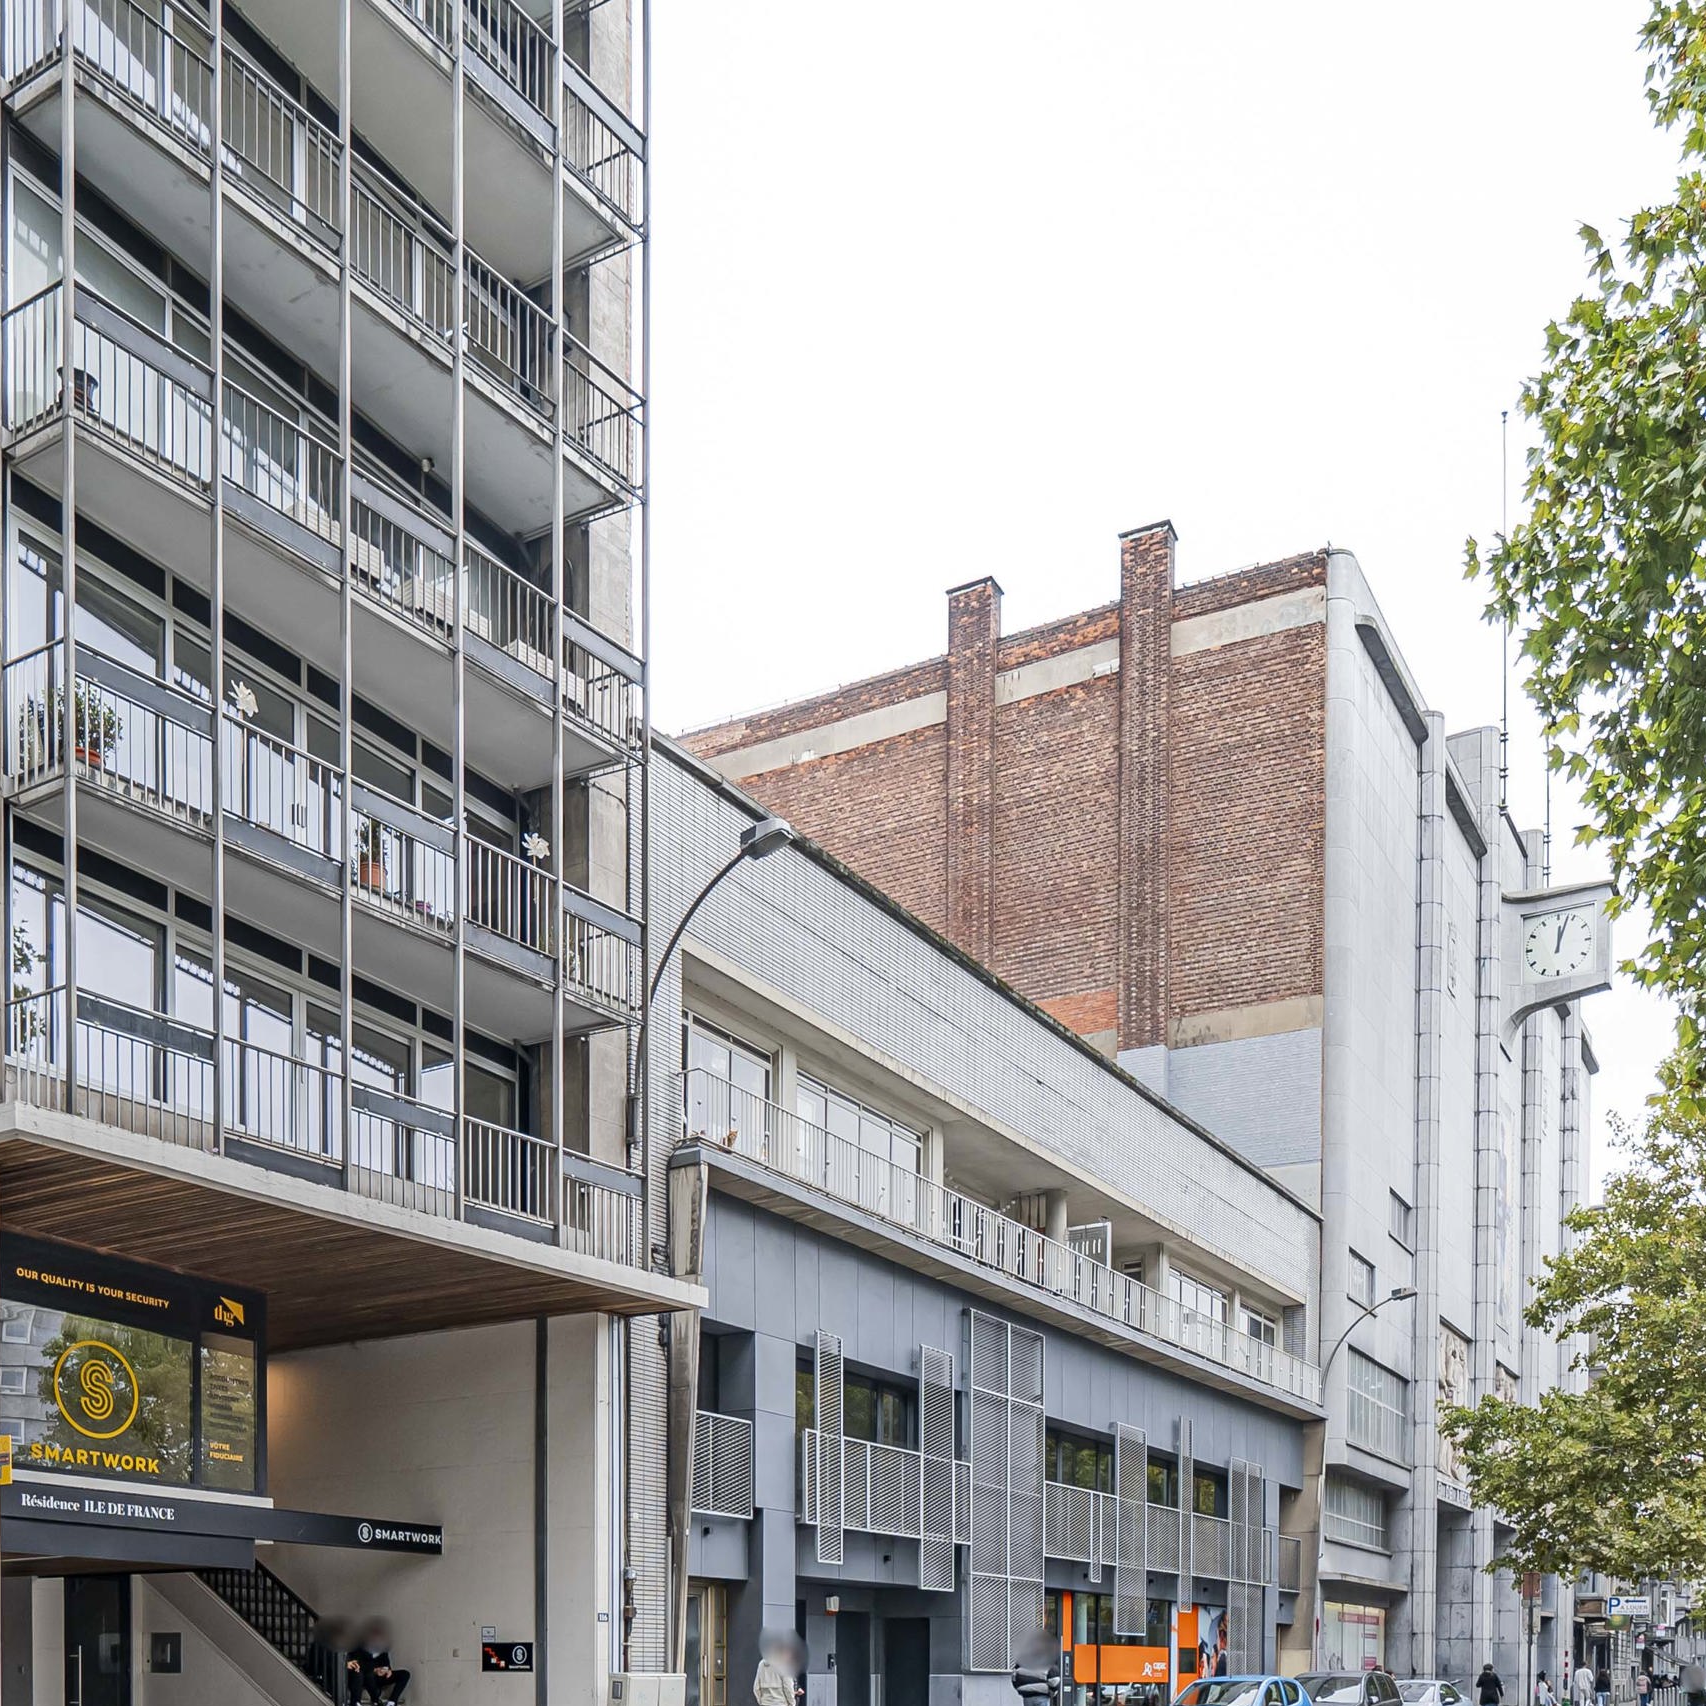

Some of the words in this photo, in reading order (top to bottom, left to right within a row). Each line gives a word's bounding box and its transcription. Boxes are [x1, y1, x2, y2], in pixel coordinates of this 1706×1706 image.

[16, 1267, 38, 1281] OUR
[40, 1272, 84, 1291] QUALITY
[86, 1283, 96, 1293] IS
[98, 1285, 124, 1299] YOUR
[125, 1292, 170, 1309] SECURITY
[30, 1442, 160, 1474] SMARTWORK
[21, 1493, 81, 1511] Résidence
[84, 1499, 106, 1513] ILE
[108, 1502, 126, 1515] DE
[127, 1504, 175, 1520] FRANCE
[375, 1528, 442, 1545] SMARTWORK
[1608, 1597, 1621, 1614] P
